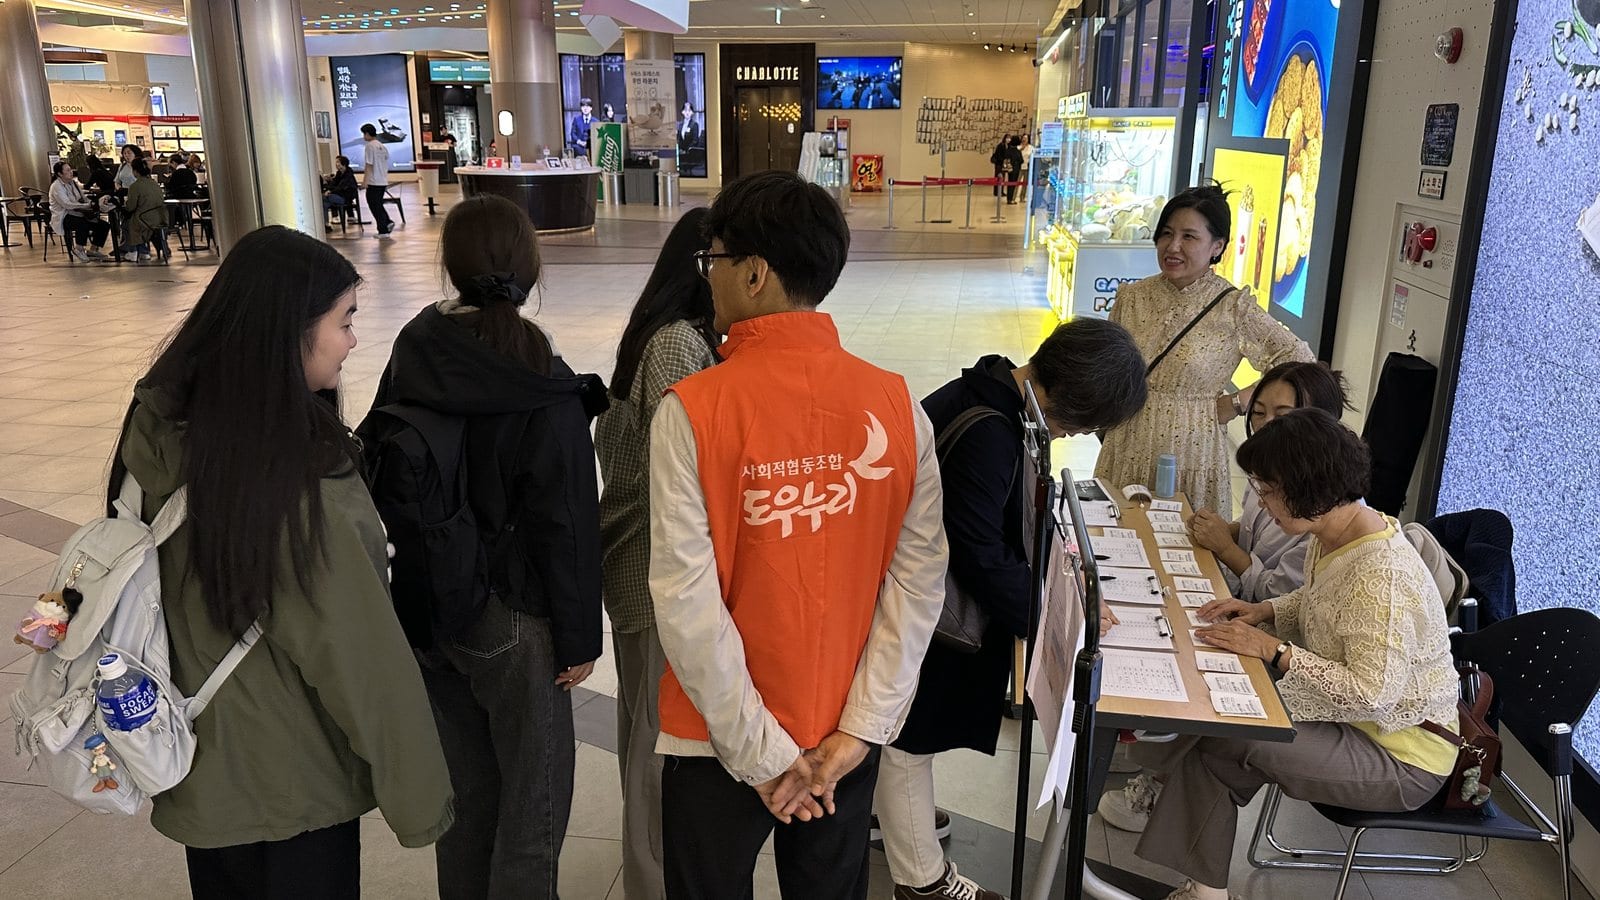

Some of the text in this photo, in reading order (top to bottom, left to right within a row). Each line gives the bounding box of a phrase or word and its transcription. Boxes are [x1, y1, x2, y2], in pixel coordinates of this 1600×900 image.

[1219, 0, 1237, 118] YING
[736, 66, 799, 81] CHARLOTTE
[60, 105, 83, 113] SOON
[742, 453, 844, 480] 사회적협동조합
[743, 471, 857, 539] 도우누리
